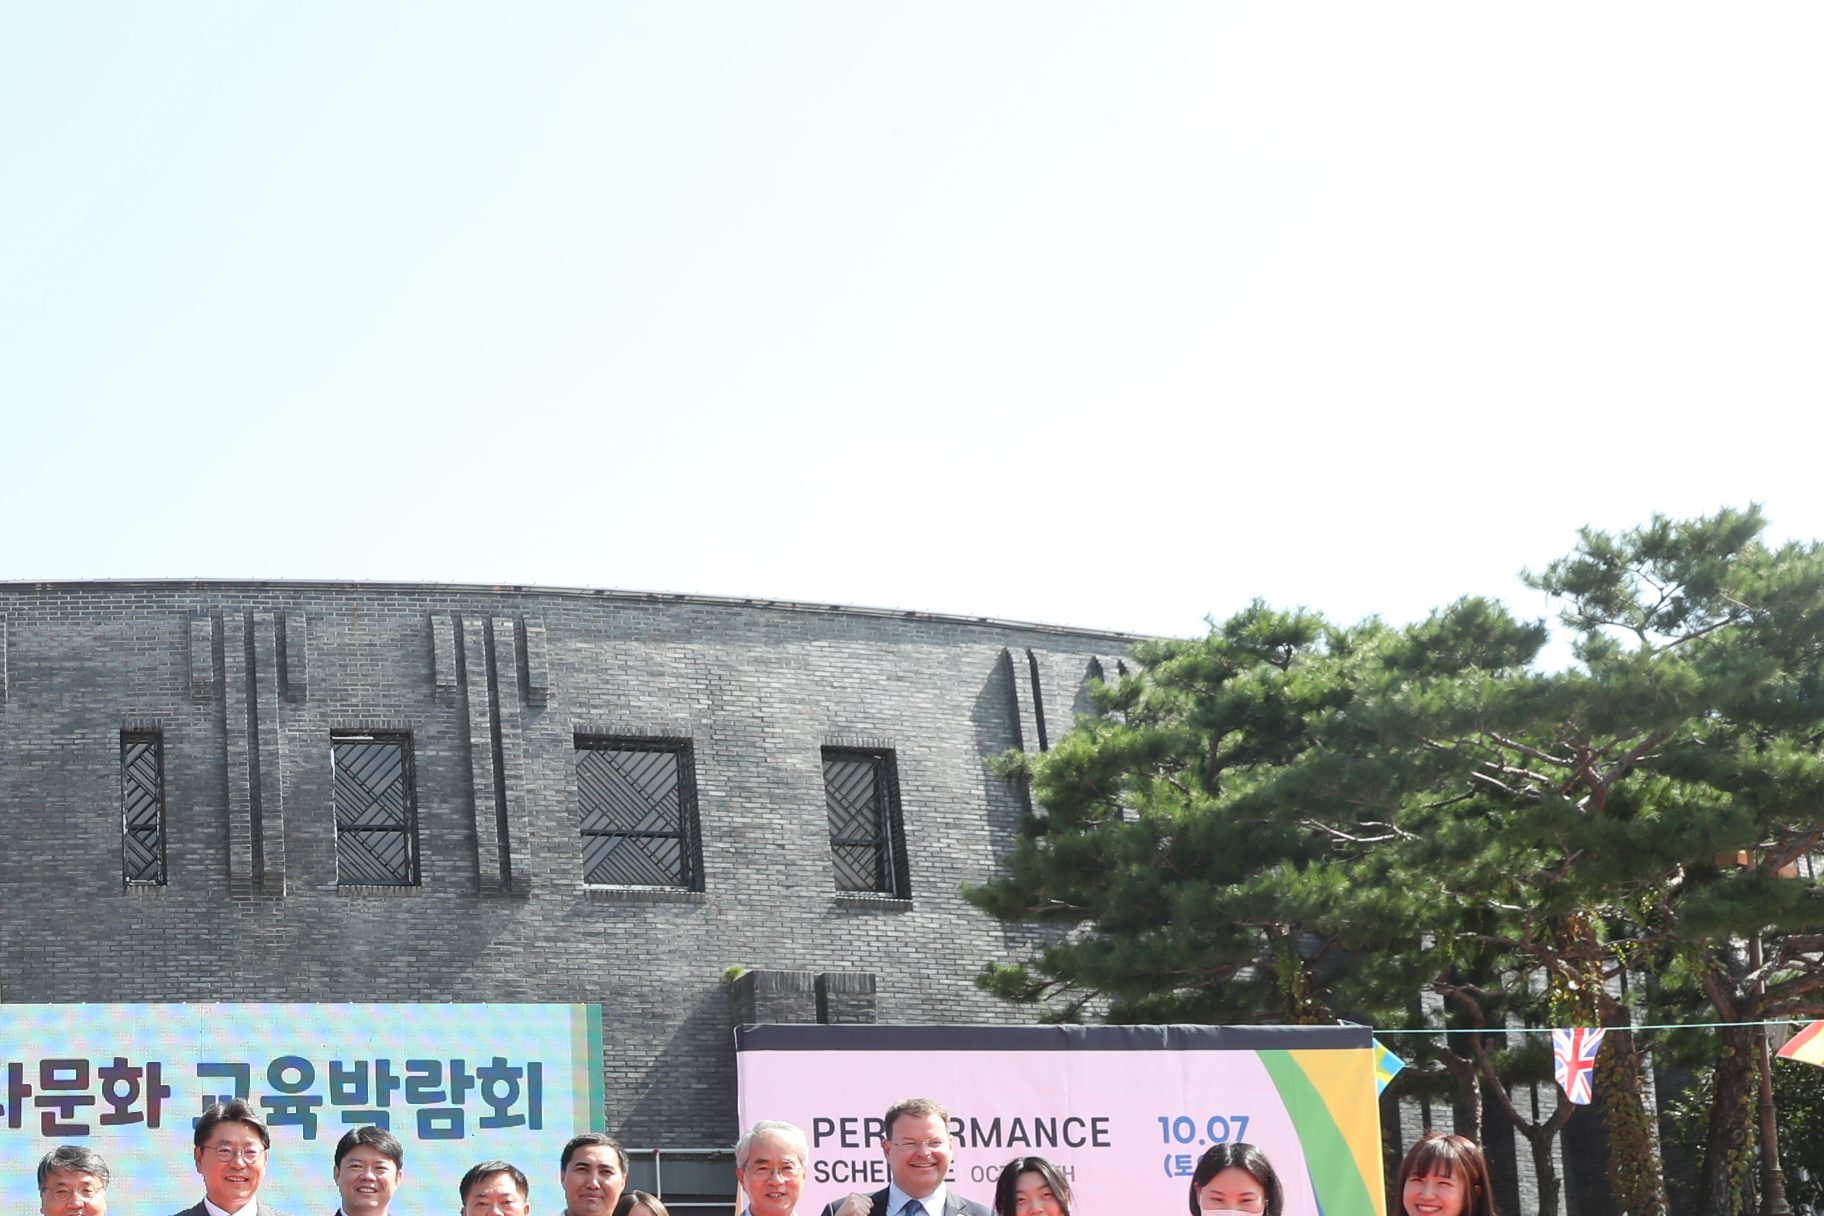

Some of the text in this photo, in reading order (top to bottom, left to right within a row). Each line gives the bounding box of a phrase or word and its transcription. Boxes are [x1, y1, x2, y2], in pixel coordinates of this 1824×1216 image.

[193, 1055, 544, 1141] 교육박람회
[812, 1117, 1112, 1149] PERRMANCE
[1157, 1115, 1250, 1146] 10.07
